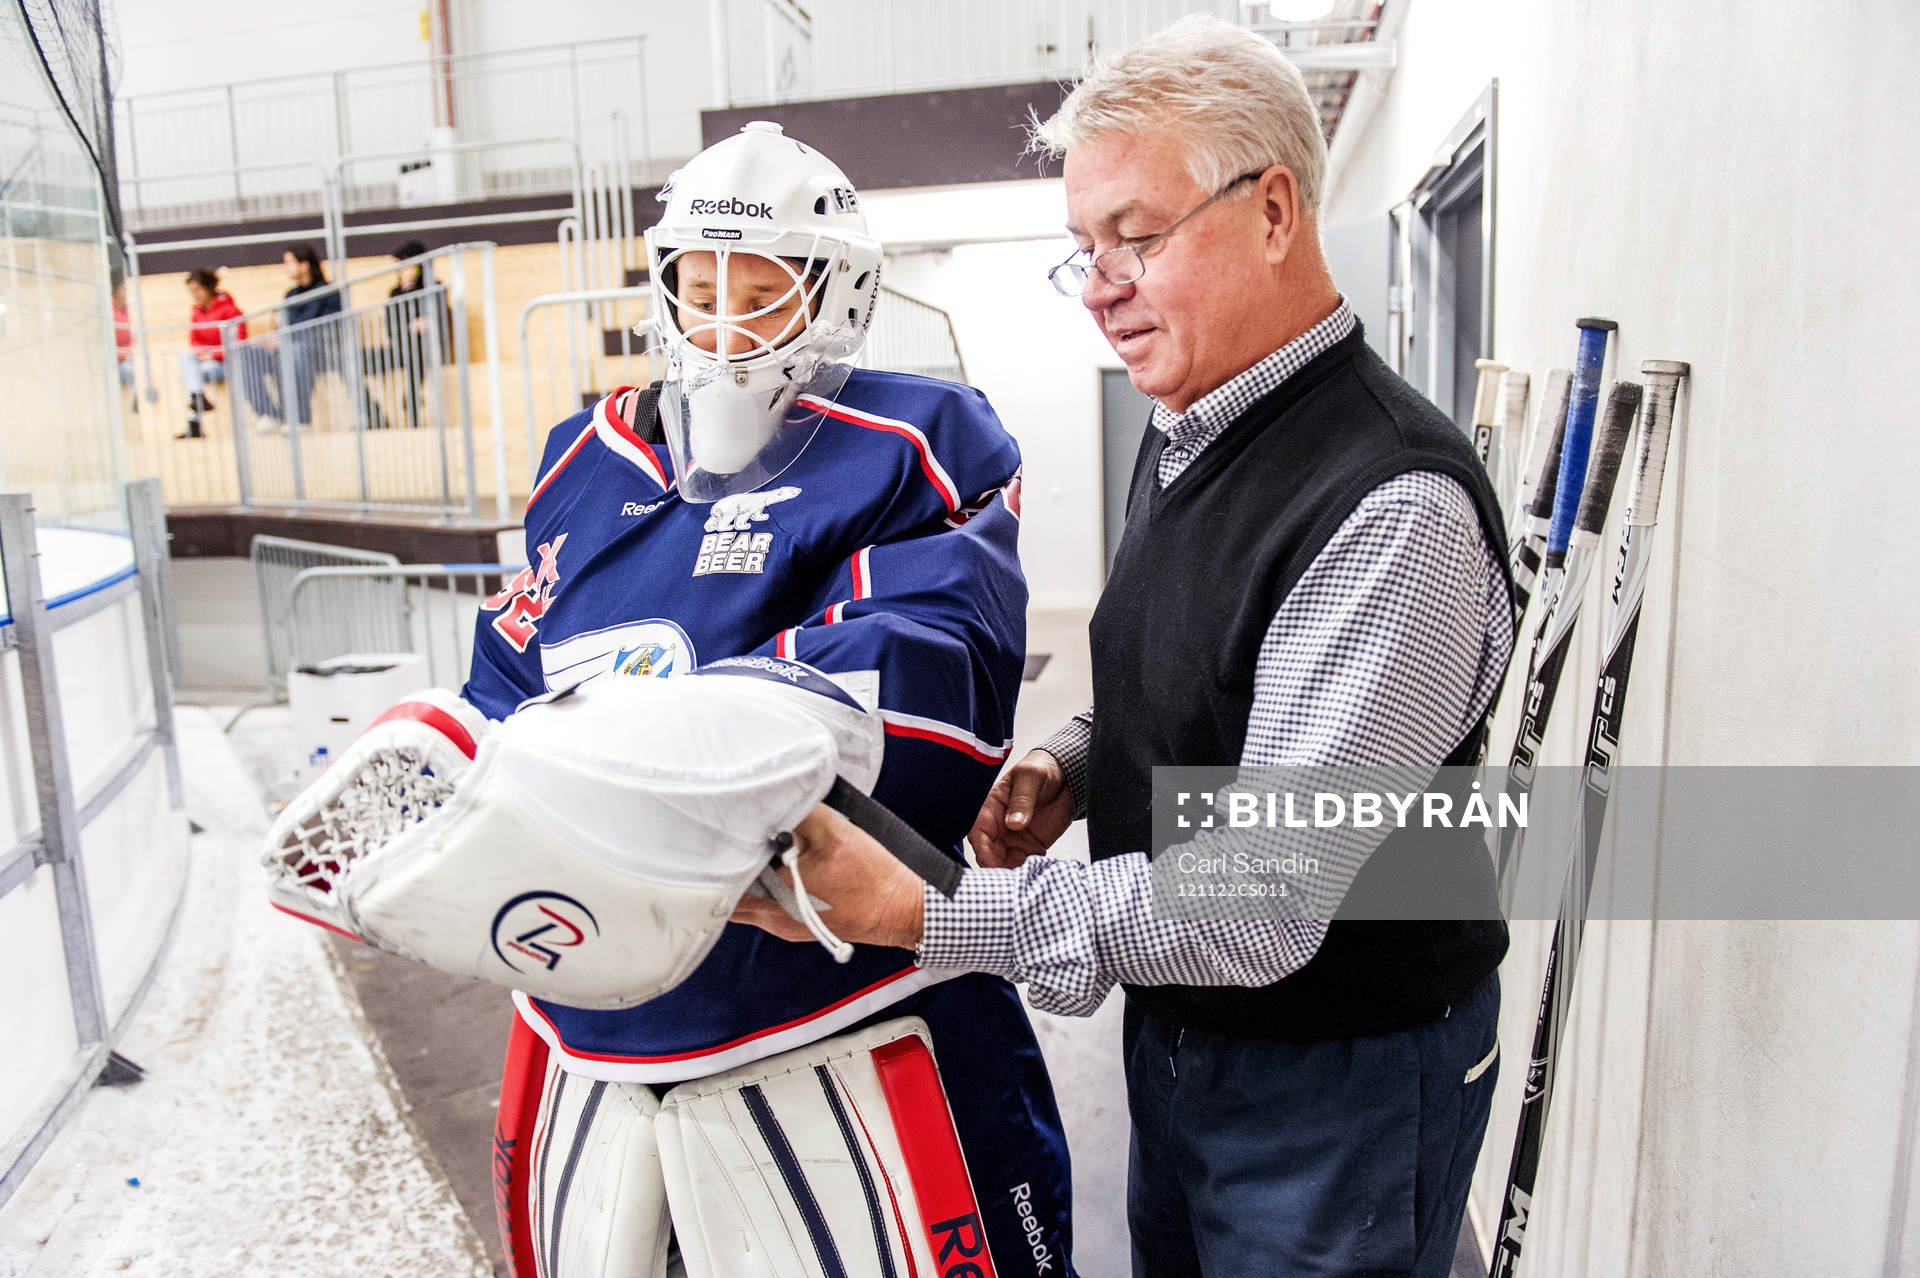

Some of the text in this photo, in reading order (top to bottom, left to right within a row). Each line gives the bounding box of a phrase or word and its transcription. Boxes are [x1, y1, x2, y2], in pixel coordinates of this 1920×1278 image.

[690, 197, 773, 220] Reebok
[700, 532, 773, 554] BEAR
[692, 552, 766, 577] BEER
[1009, 1182, 1052, 1276] Reebok
